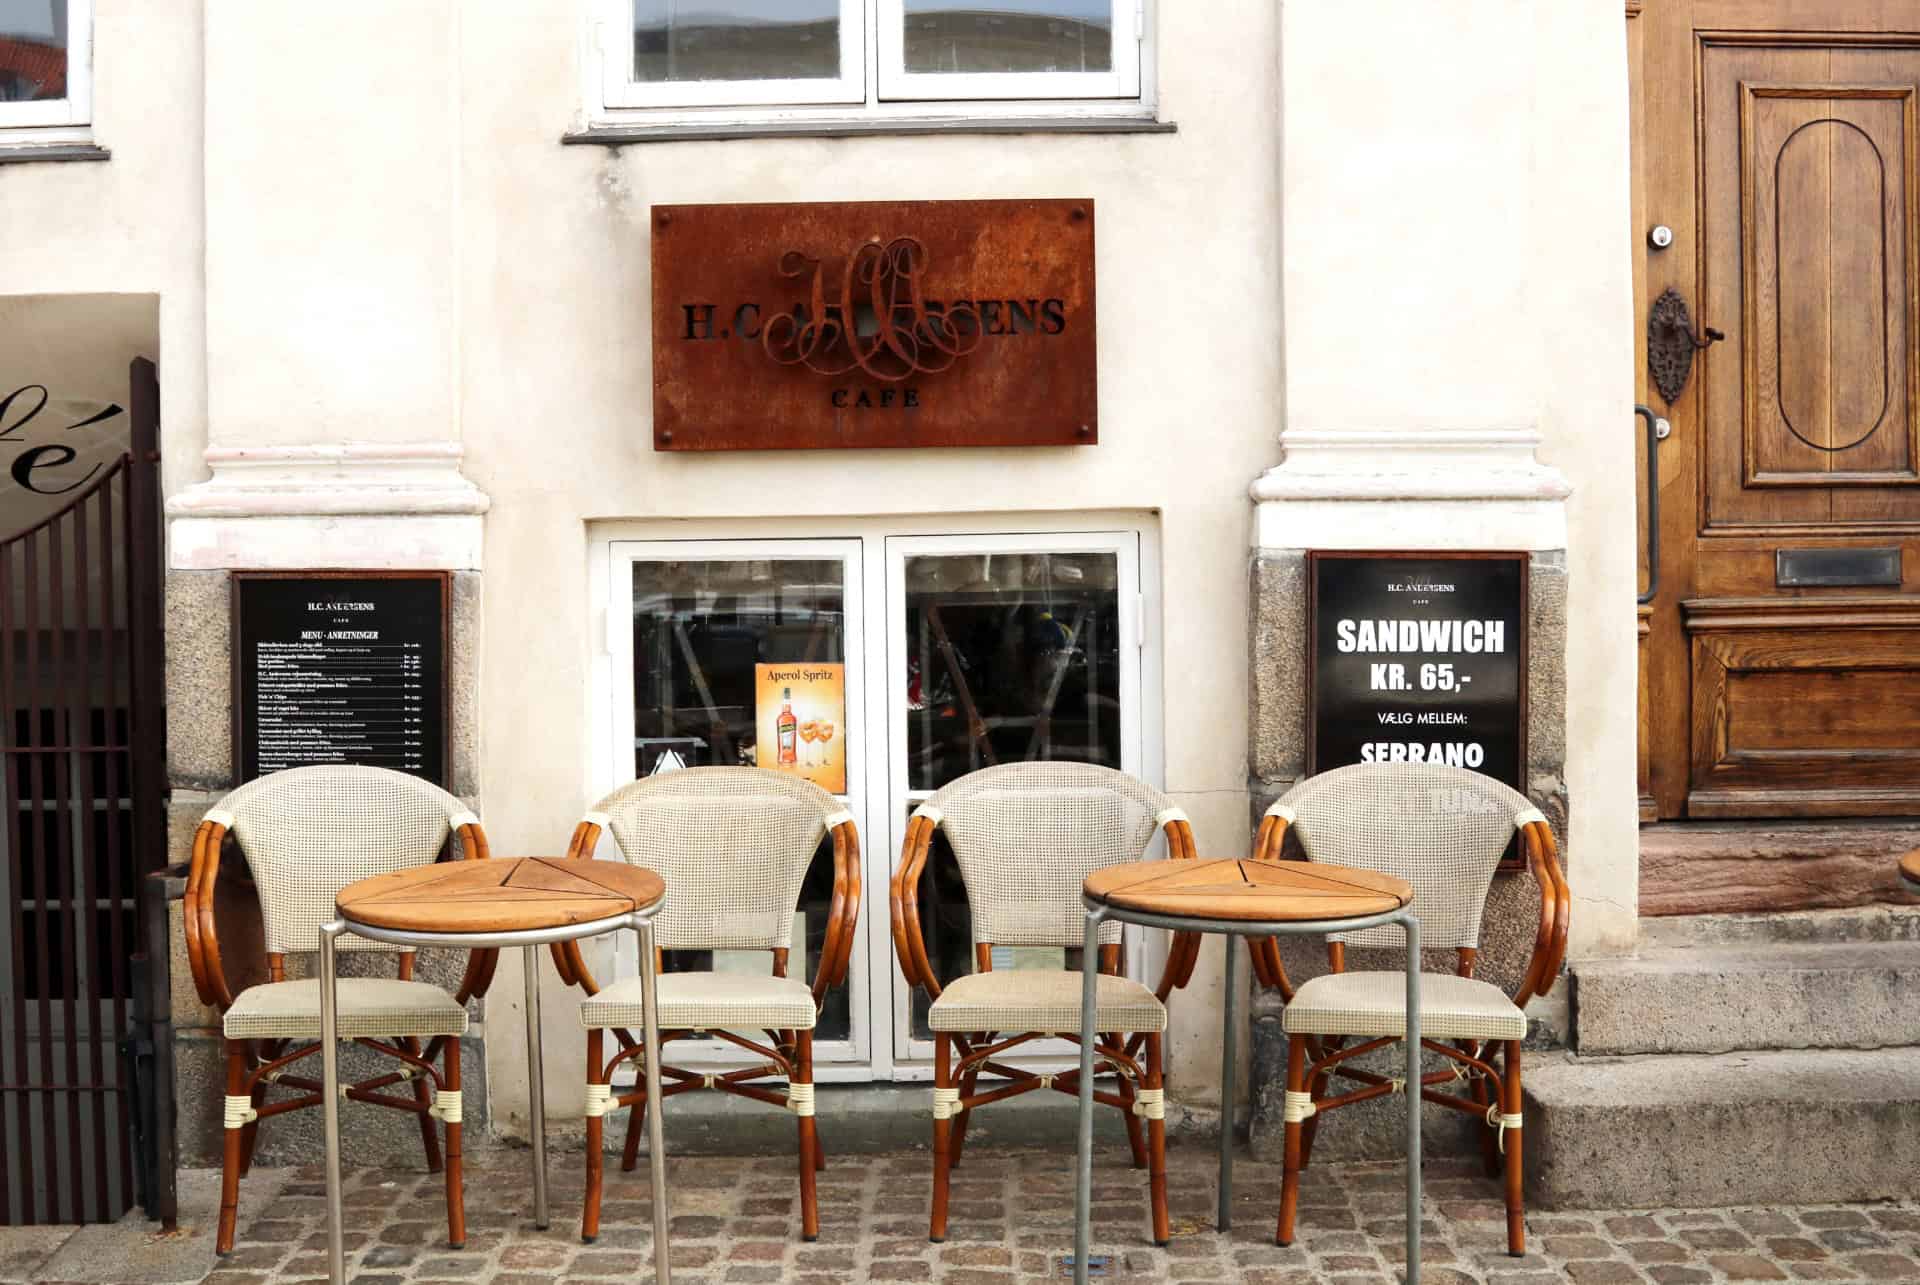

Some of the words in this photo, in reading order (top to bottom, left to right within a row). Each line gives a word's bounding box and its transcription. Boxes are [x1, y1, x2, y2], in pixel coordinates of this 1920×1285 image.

[831, 389, 919, 409] CAFE
[300, 630, 323, 640] MENU
[327, 630, 379, 640] ANRETNINGER
[1336, 618, 1505, 654] SANDWICH
[767, 670, 801, 683] Aperol
[803, 670, 833, 683] Spritz
[1370, 662, 1413, 691] KR.
[1419, 662, 1472, 694] 65,-
[1377, 712, 1414, 725] VÆLG
[1416, 712, 1468, 725] MELLEM:
[1360, 742, 1485, 769] SERRANO
